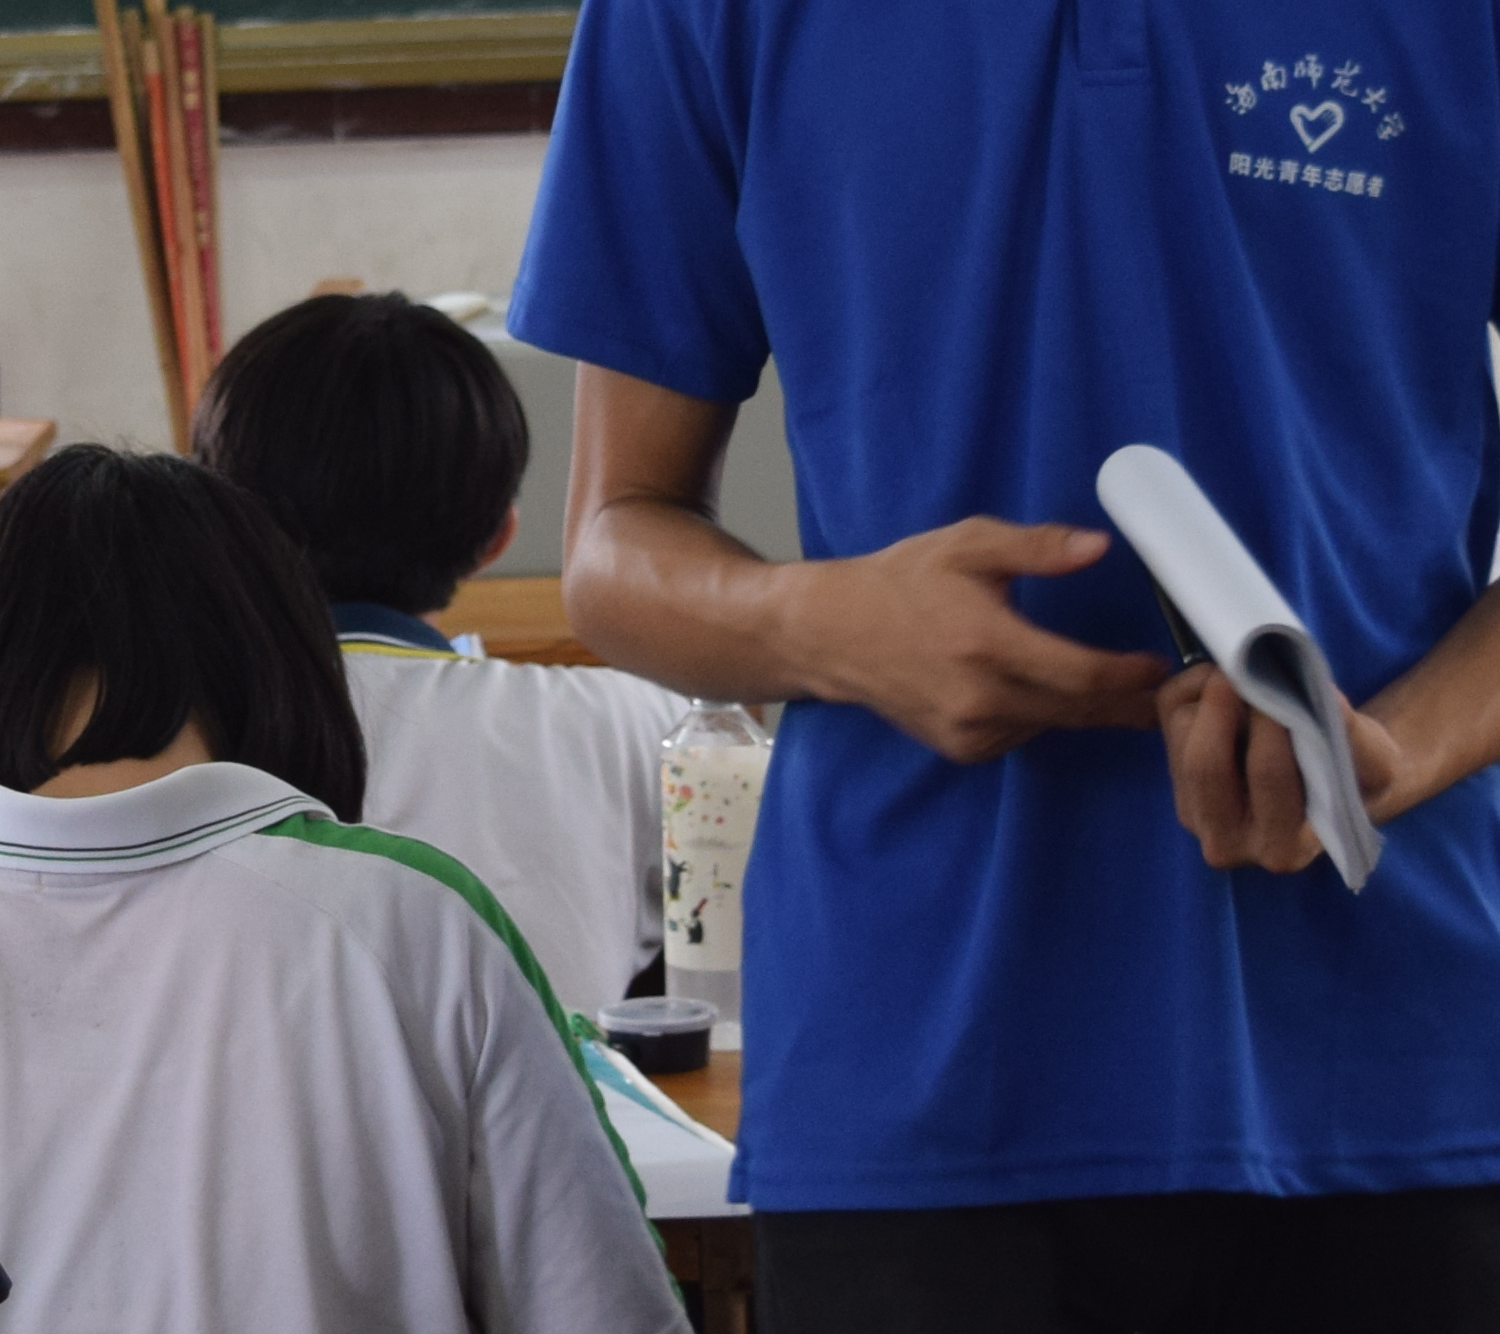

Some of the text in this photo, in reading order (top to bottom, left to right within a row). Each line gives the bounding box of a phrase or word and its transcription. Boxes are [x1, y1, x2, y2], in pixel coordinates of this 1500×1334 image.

[1228, 151, 1385, 199] 阳光青年志愿者
